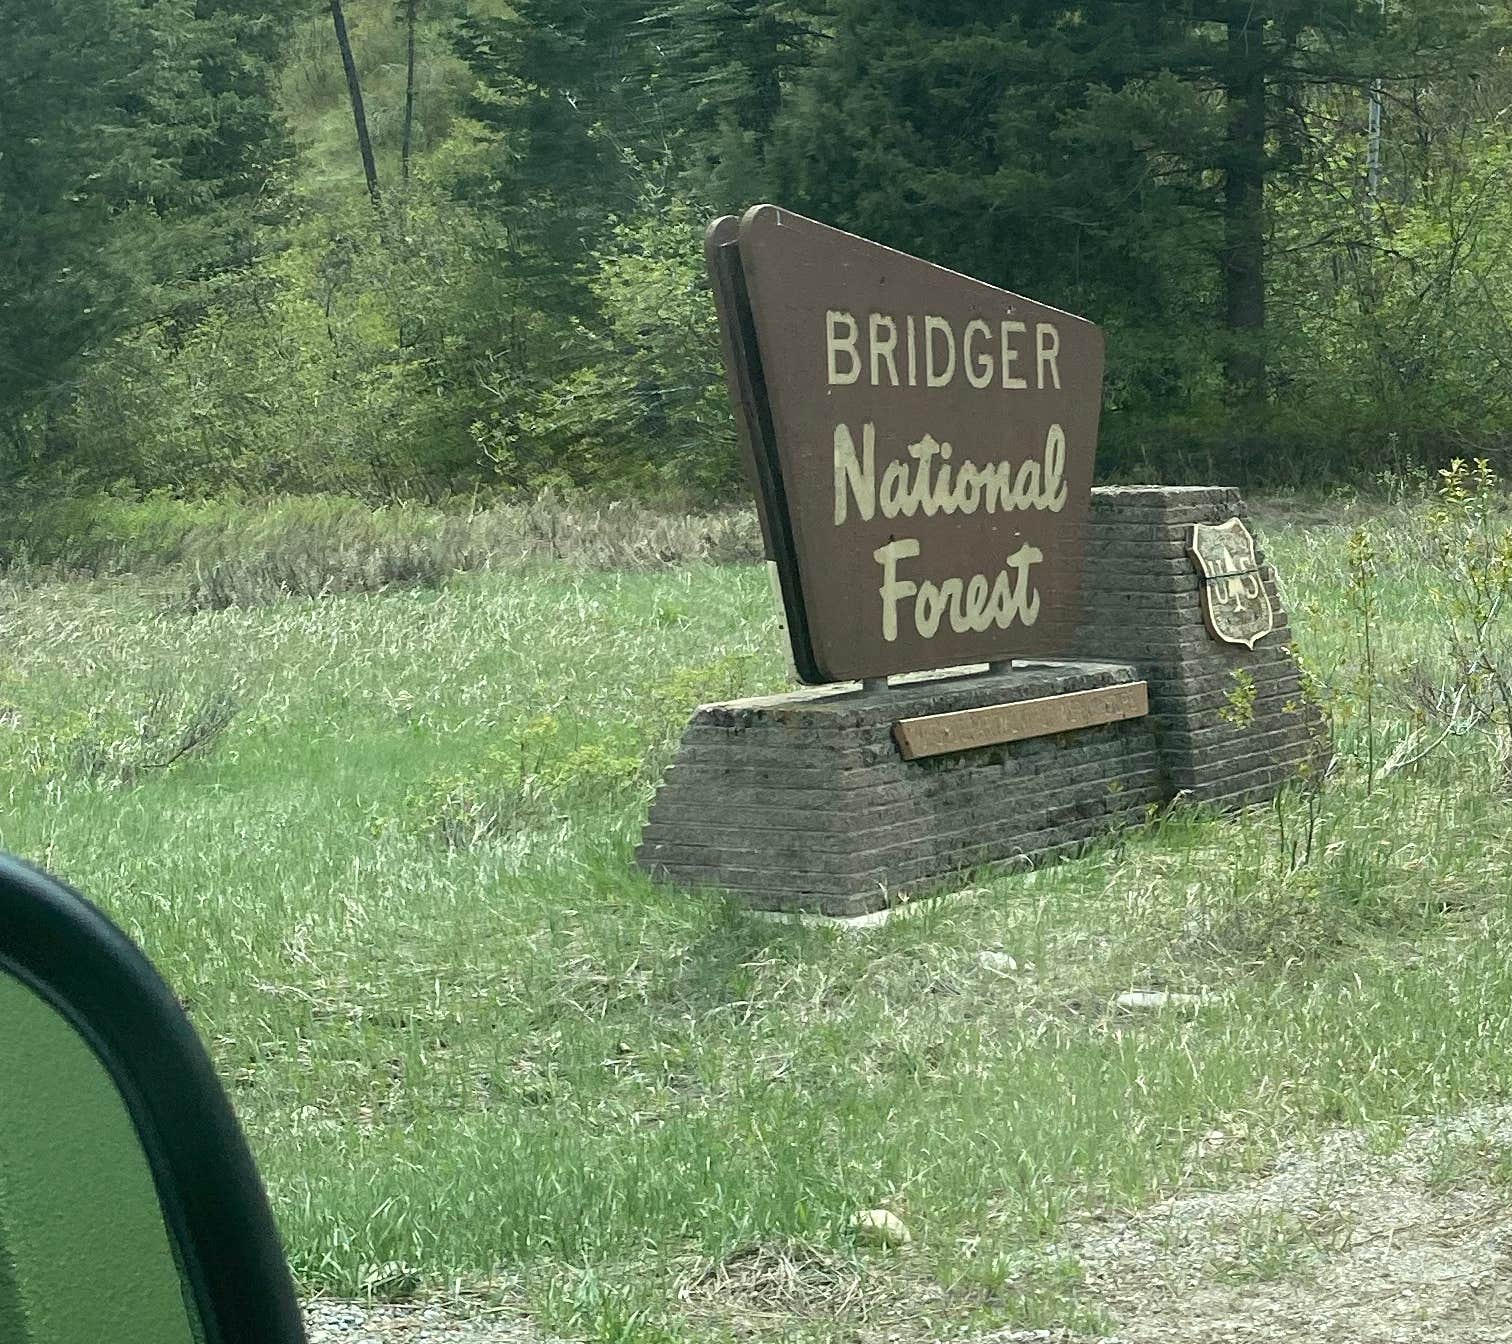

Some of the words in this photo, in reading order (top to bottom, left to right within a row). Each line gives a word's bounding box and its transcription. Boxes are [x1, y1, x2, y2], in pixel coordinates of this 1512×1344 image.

[826, 309, 1061, 389] BRIDGER
[833, 420, 1068, 526] National
[873, 538, 1044, 642] Forest
